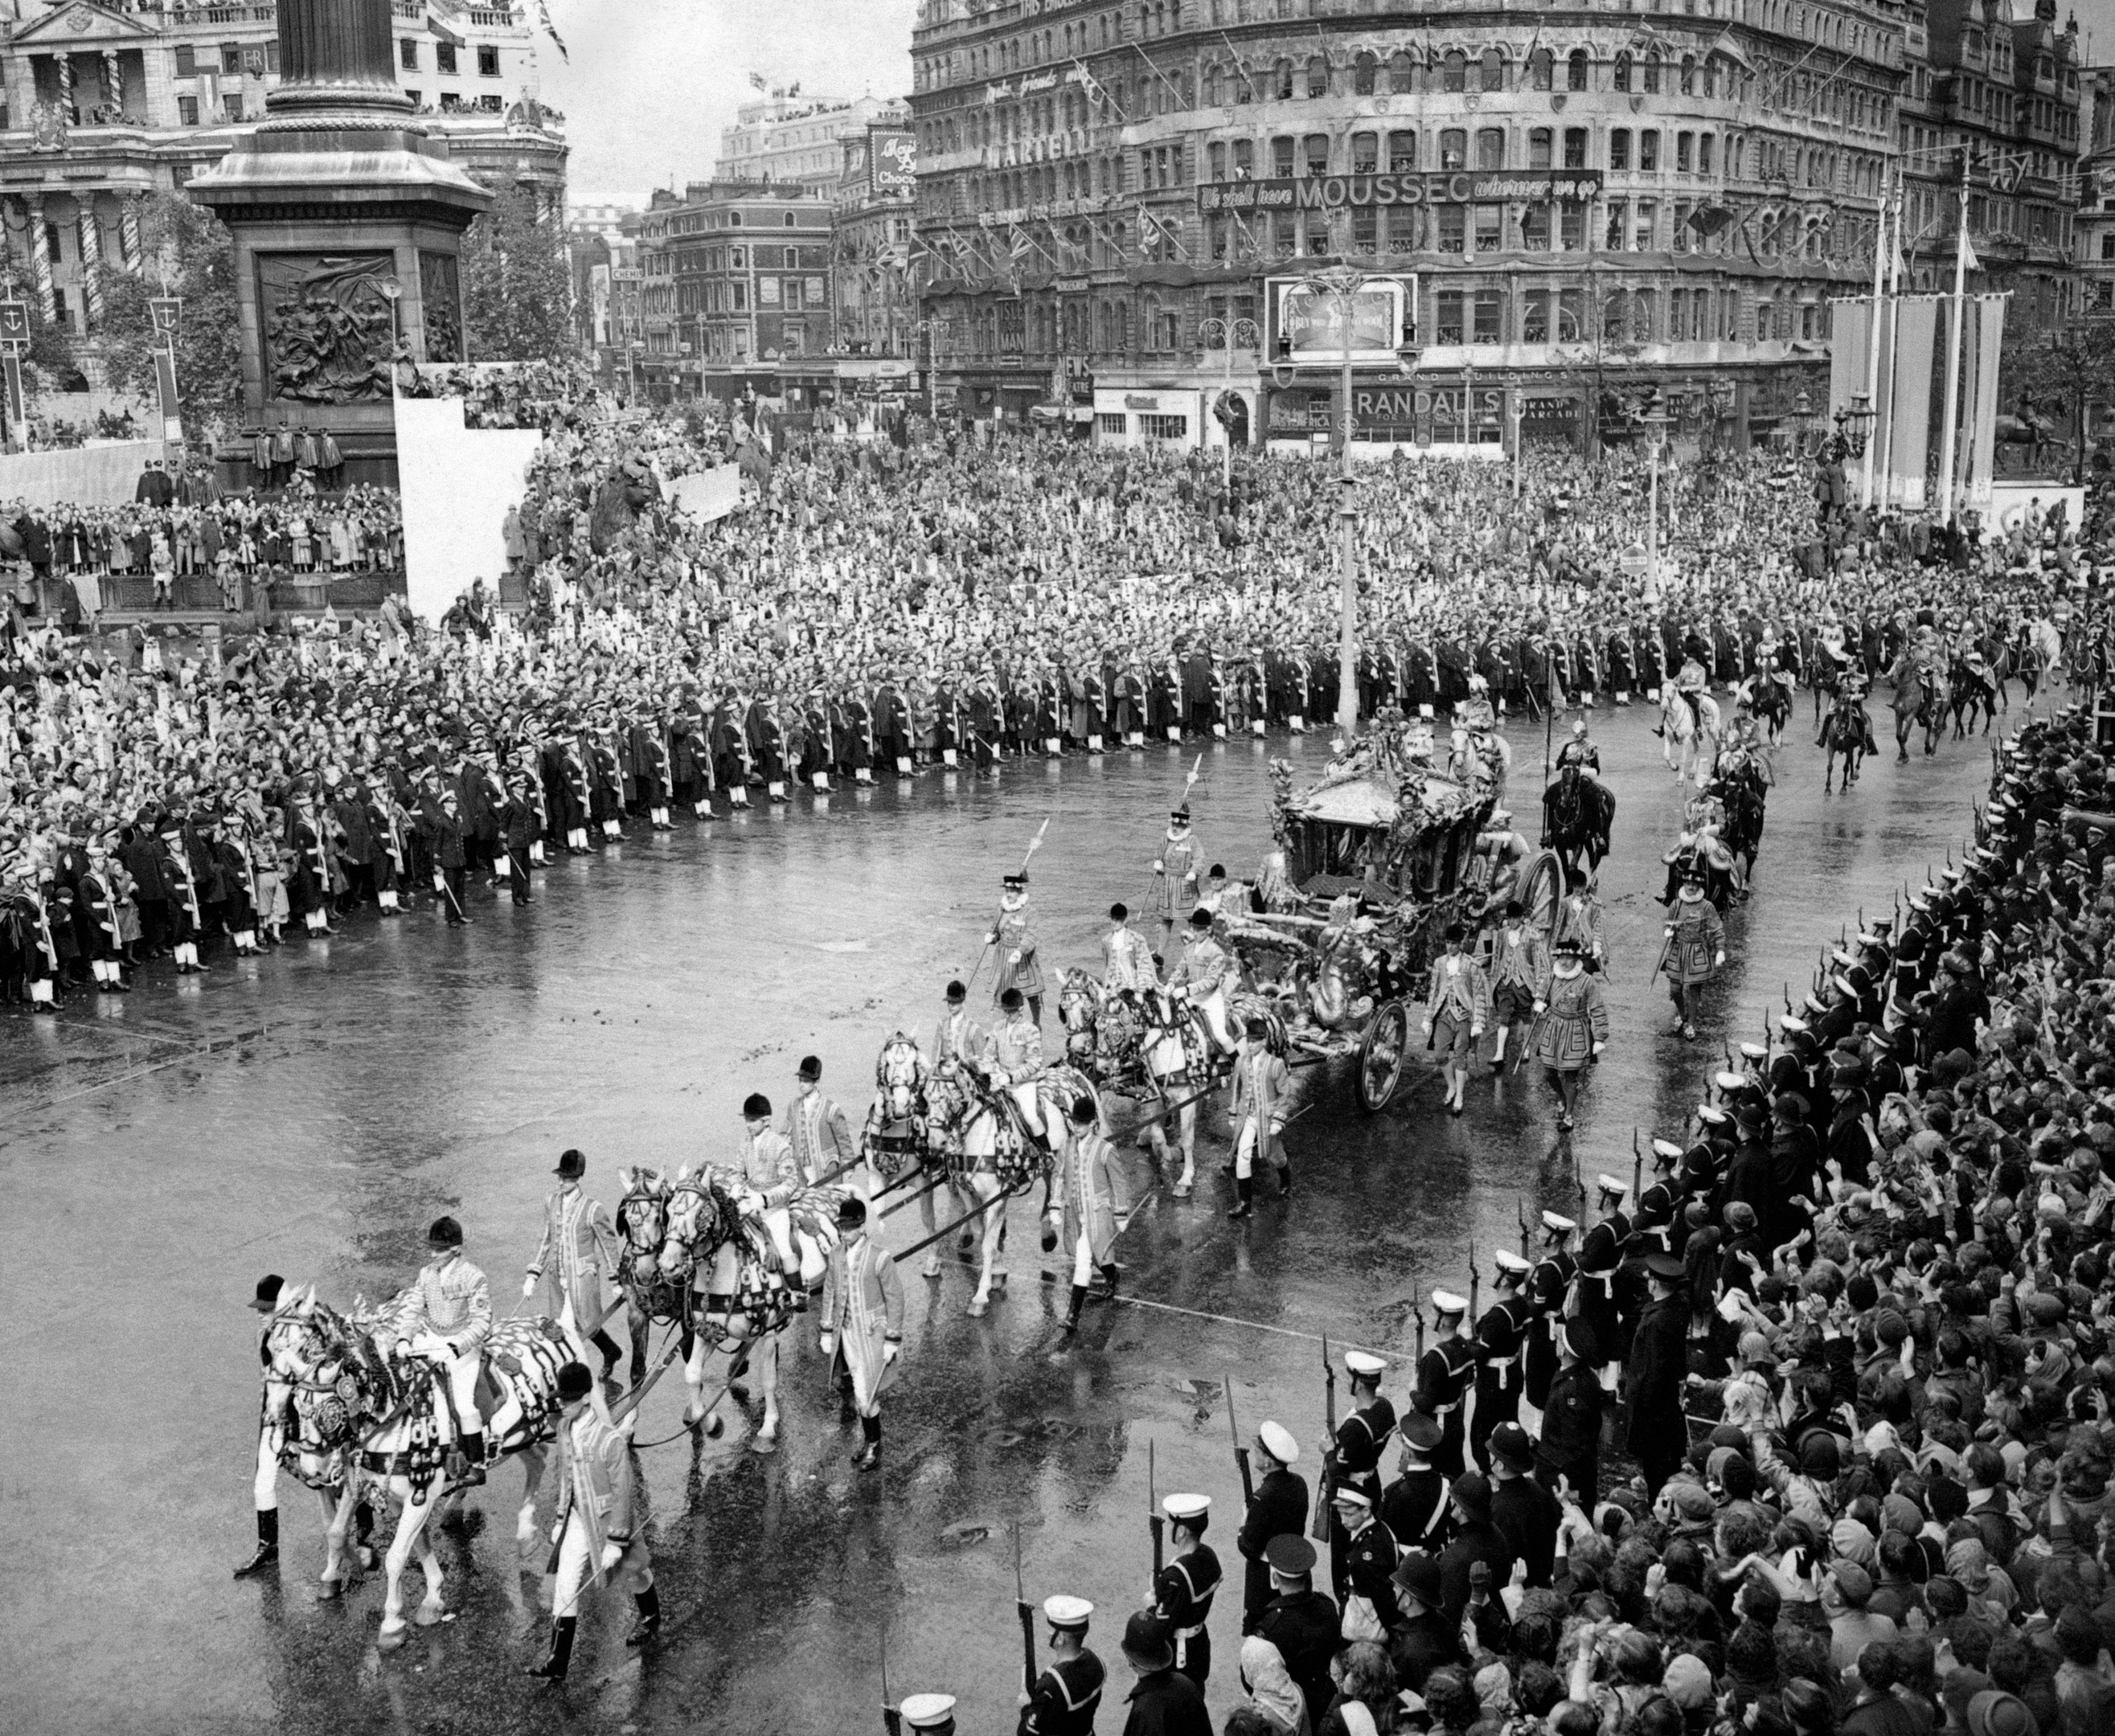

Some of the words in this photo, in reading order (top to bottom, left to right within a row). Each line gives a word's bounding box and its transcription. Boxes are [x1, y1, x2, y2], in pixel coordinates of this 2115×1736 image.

[986, 127, 1095, 170] MARTELL
[1201, 186, 1220, 209] We
[1222, 183, 1256, 207] shall
[1257, 182, 1293, 205] have
[1296, 172, 1471, 207] MOUSSEC
[1474, 174, 1551, 197] wherever
[1552, 179, 1576, 195] we
[1577, 179, 1597, 201] go
[1000, 302, 1025, 320] ISLE
[1000, 333, 1025, 351] MAN
[1057, 355, 1089, 378] NEWS
[1378, 373, 1439, 381] GRAND
[1460, 371, 1568, 381] BUILDINGS
[1357, 391, 1501, 414] RANDALLS
